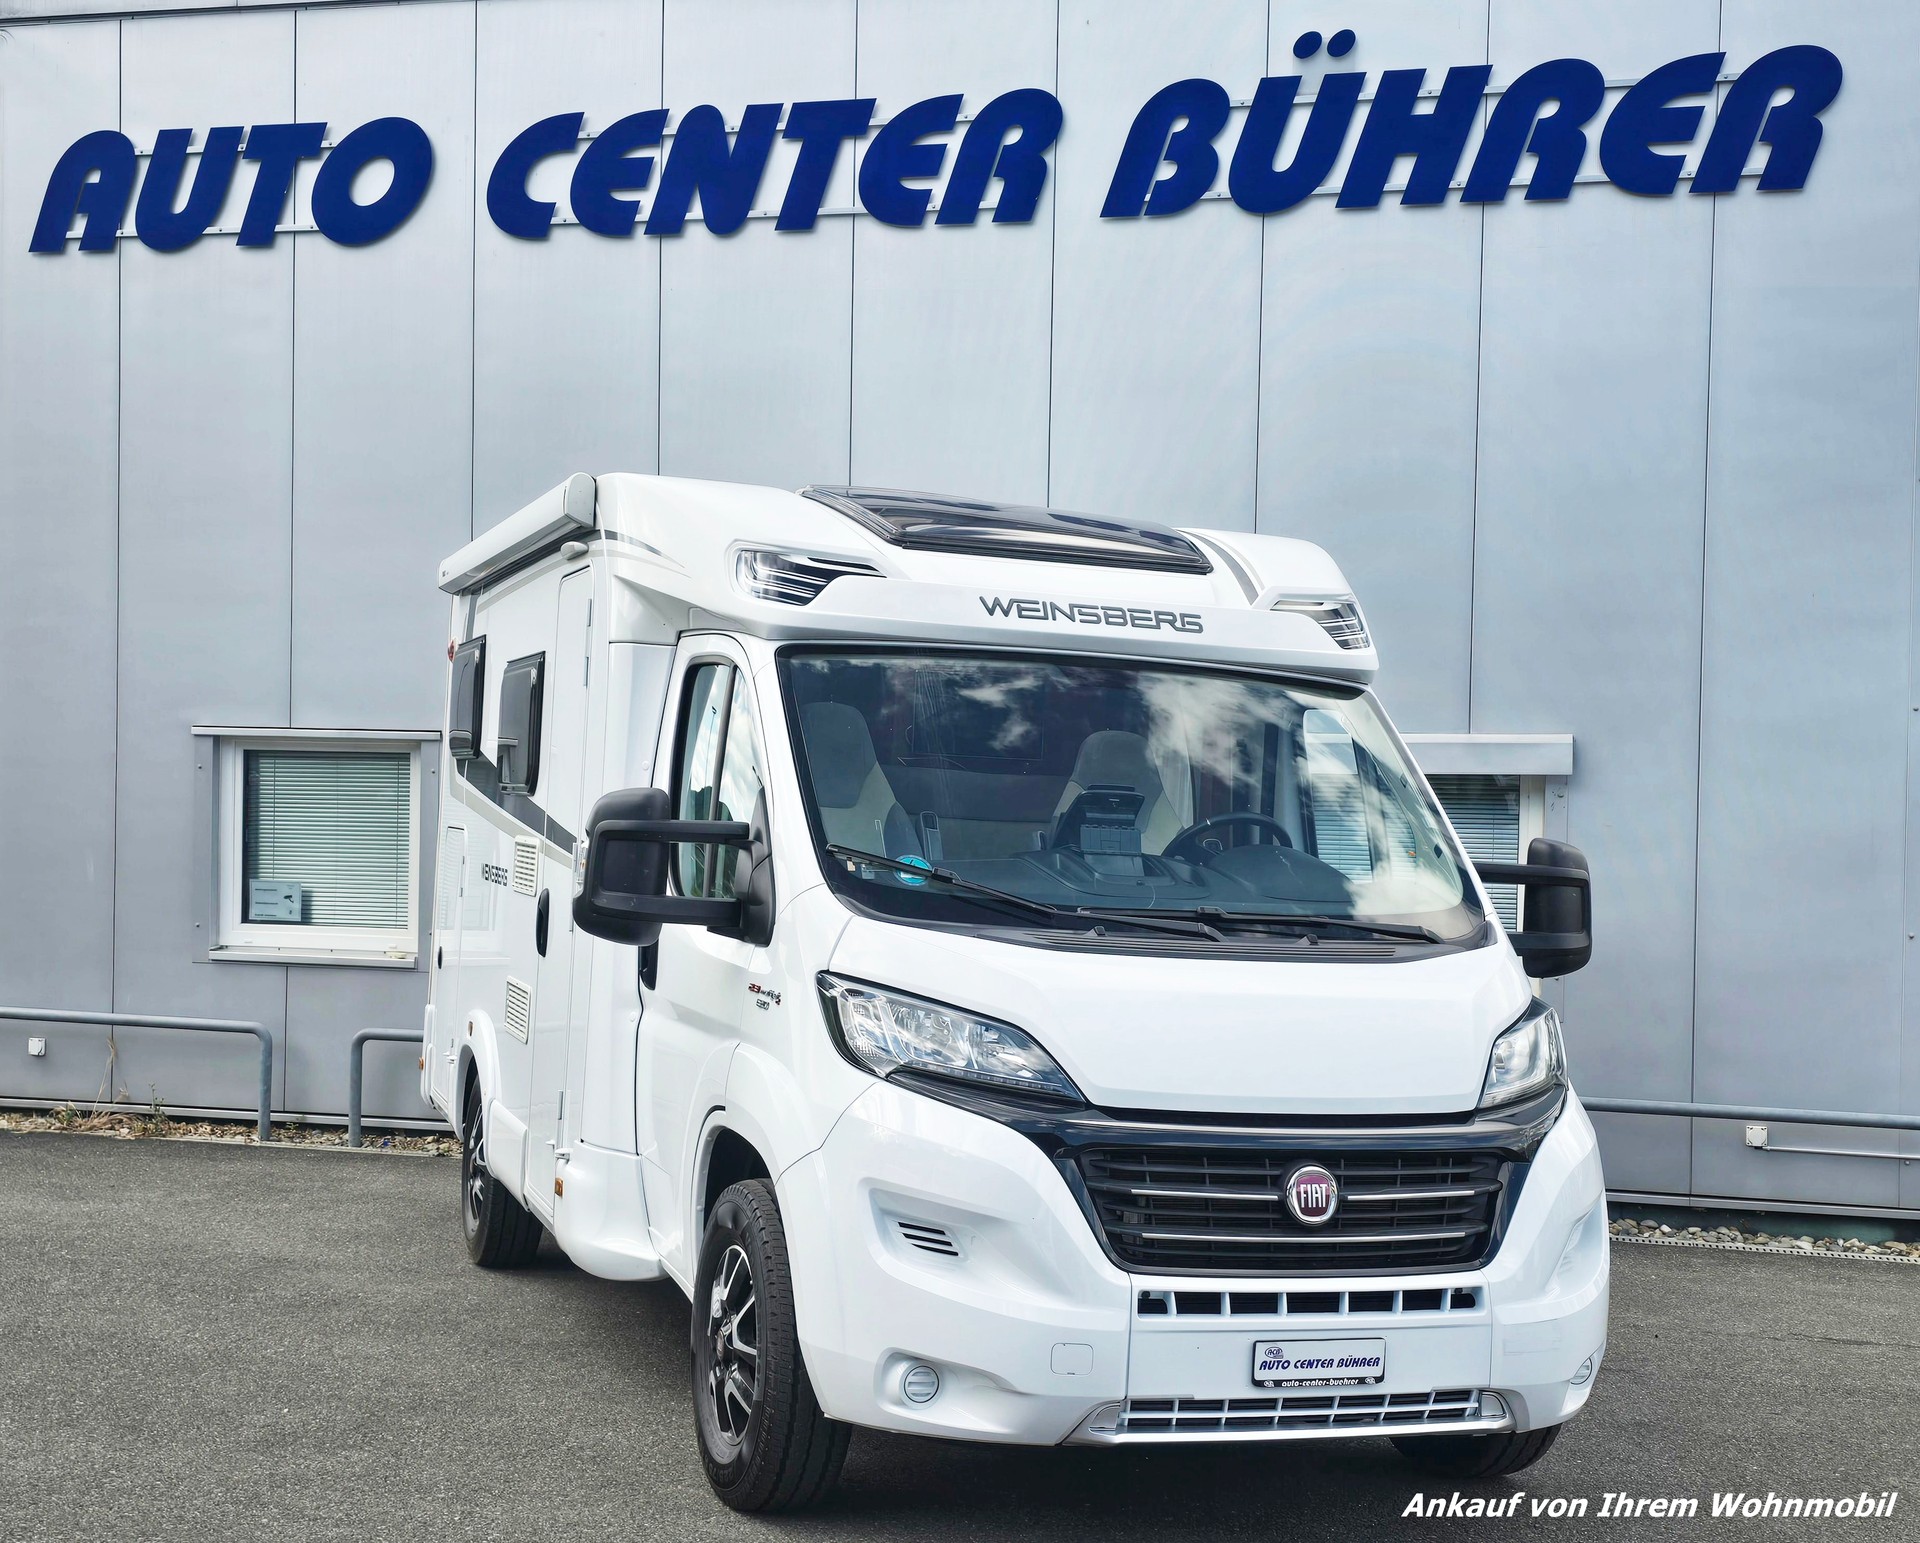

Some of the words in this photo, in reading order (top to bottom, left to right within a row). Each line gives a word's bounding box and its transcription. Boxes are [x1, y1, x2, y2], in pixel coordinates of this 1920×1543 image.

[29, 116, 434, 255] AUTO
[486, 87, 1064, 241] CENTER
[1099, 28, 1844, 219] BÜHRER
[978, 595, 1205, 635] WEINSBERG
[1299, 1183, 1328, 1208] FIAT
[1258, 1359, 1291, 1371] AUTO
[1293, 1358, 1335, 1369] CENTER
[1336, 1354, 1381, 1369] BÜHRER
